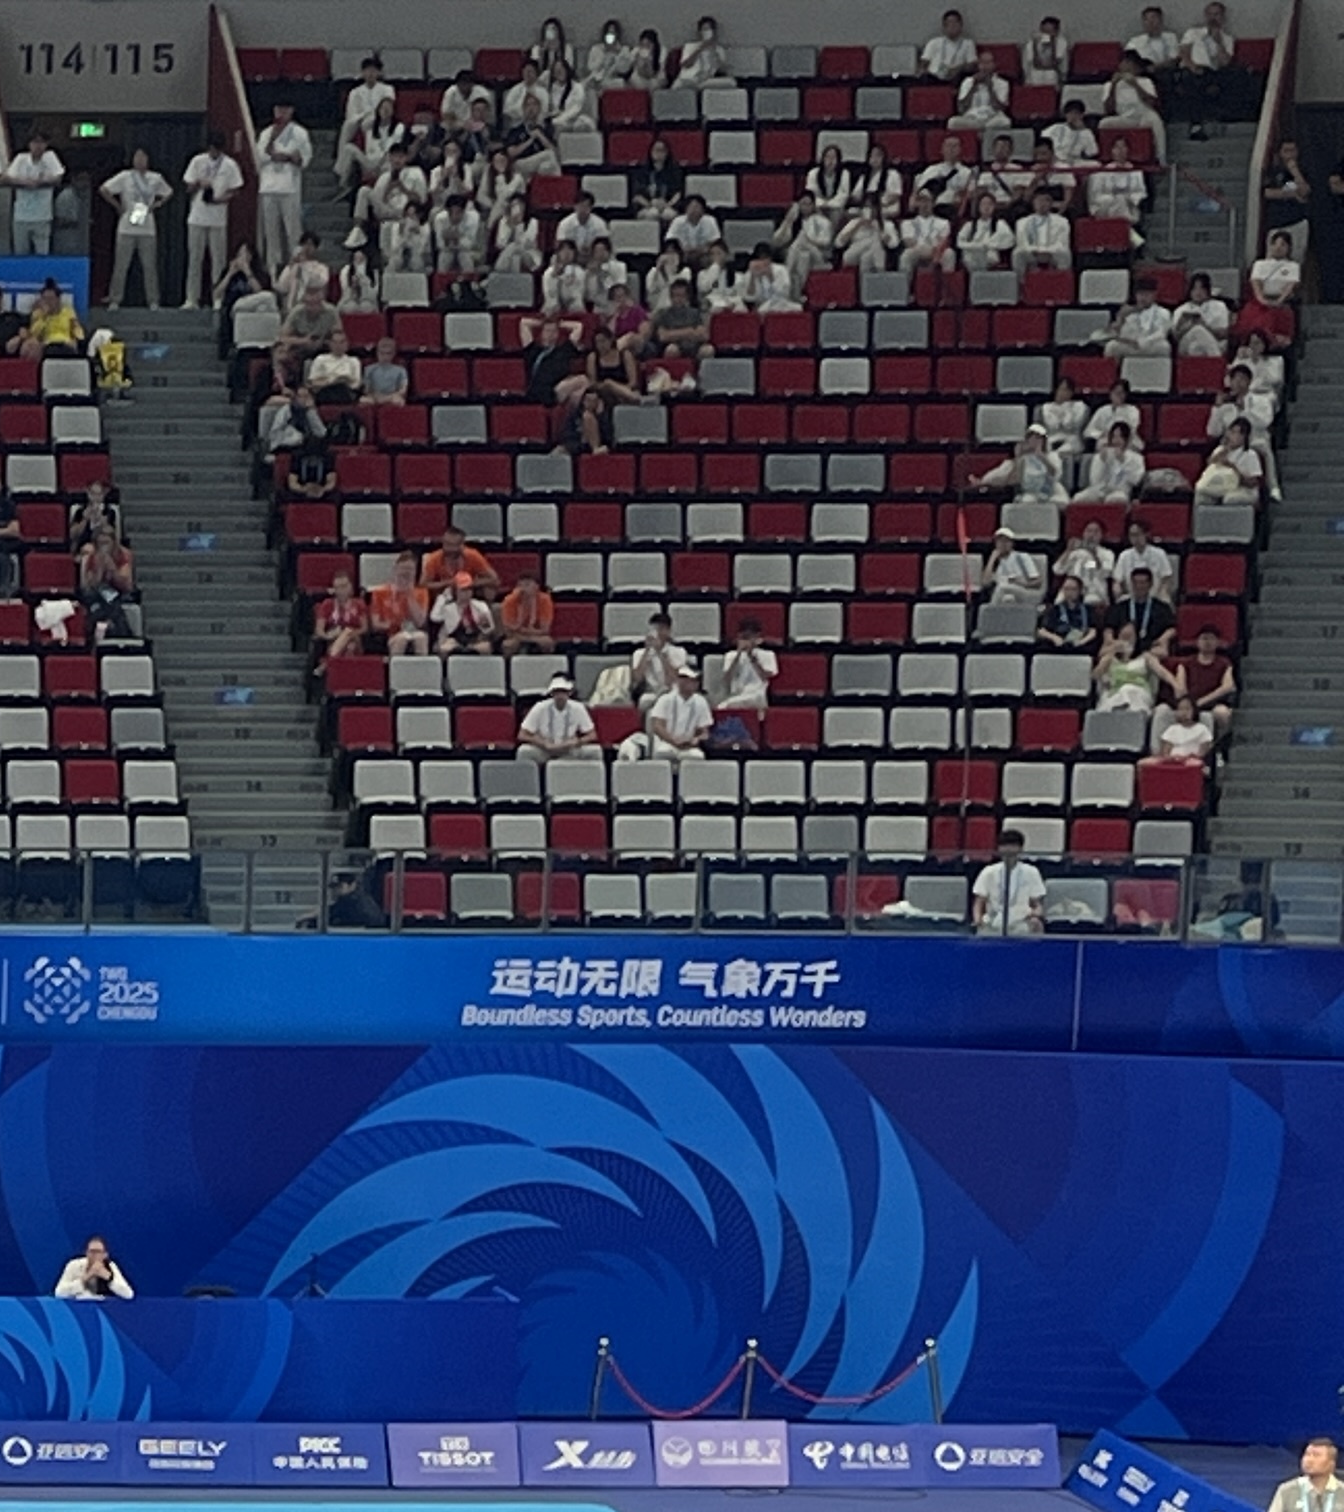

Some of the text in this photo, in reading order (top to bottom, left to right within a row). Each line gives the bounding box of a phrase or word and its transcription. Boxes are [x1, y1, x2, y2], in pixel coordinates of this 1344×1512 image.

[18, 42, 174, 75] 114 115
[490, 957, 841, 999] 运动无限 气象万千
[99, 982, 159, 1003] 2025
[462, 1005, 866, 1029] Boundless Sports, Countless Wonders
[417, 1451, 495, 1466] TISSOT
